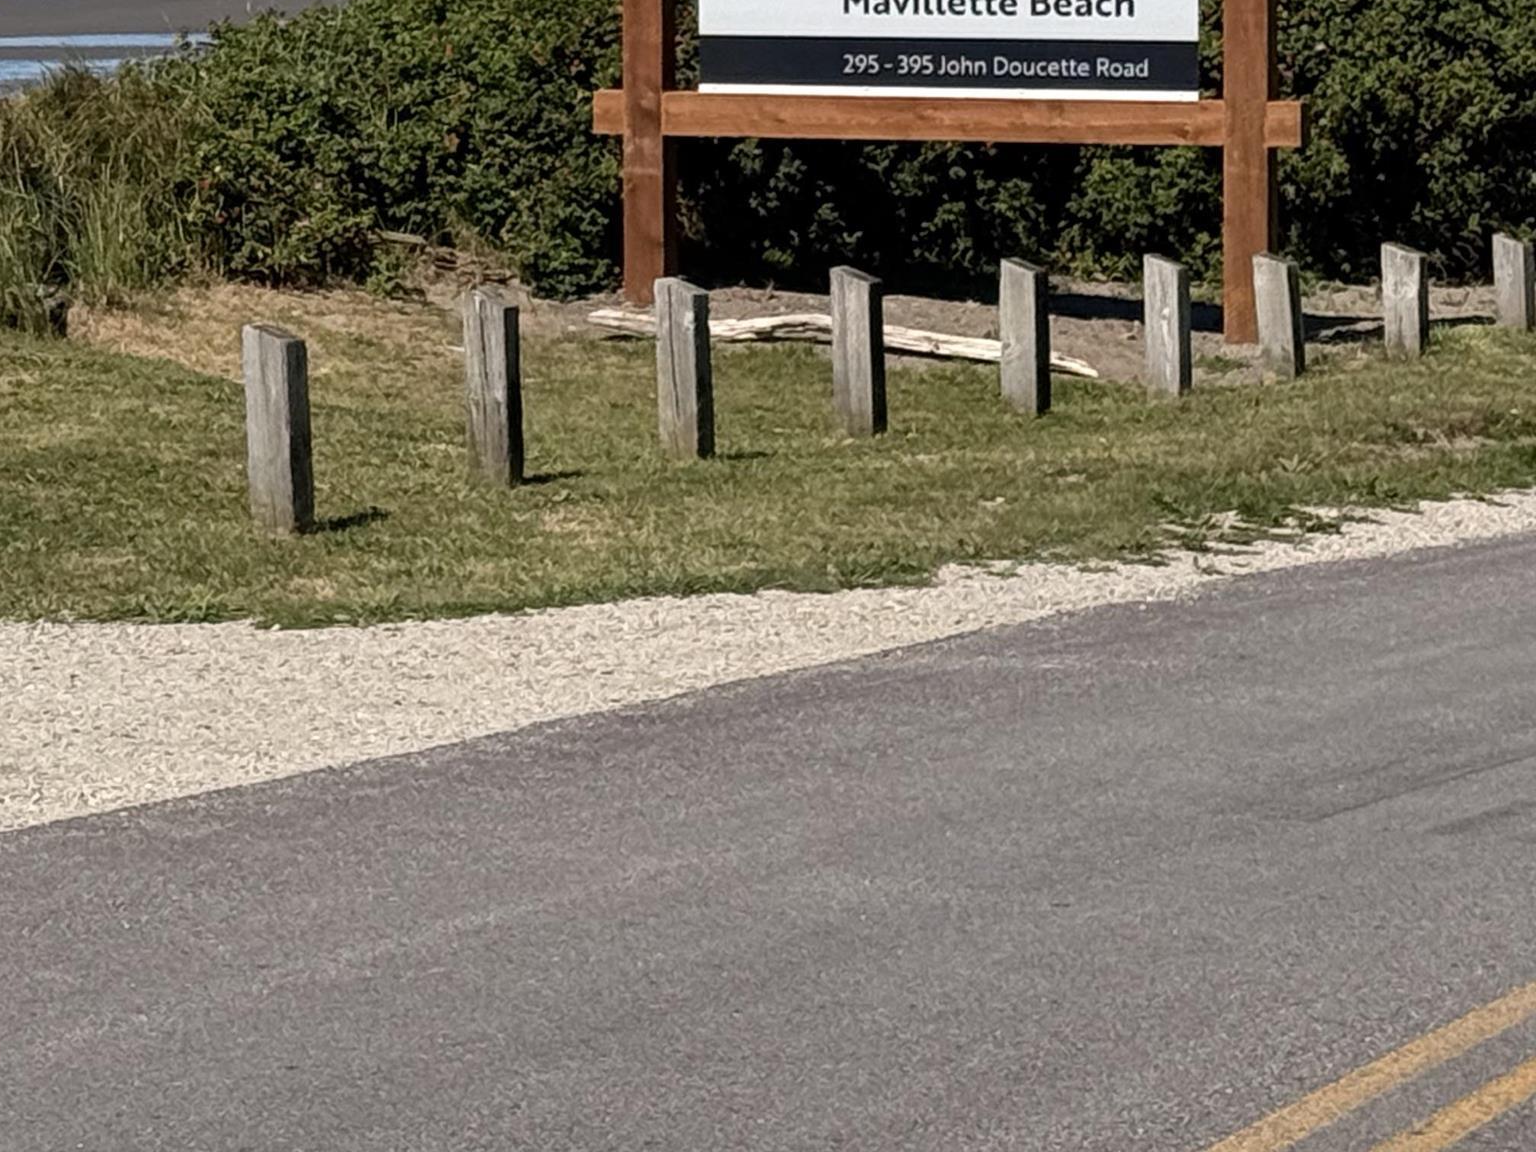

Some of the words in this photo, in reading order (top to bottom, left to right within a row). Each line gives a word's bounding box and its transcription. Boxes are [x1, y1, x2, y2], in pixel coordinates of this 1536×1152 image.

[842, 54, 880, 74] 295
[897, 54, 934, 75] 395
[937, 55, 987, 76] John
[993, 56, 1090, 77] Doucette
[1096, 58, 1149, 77] Road
